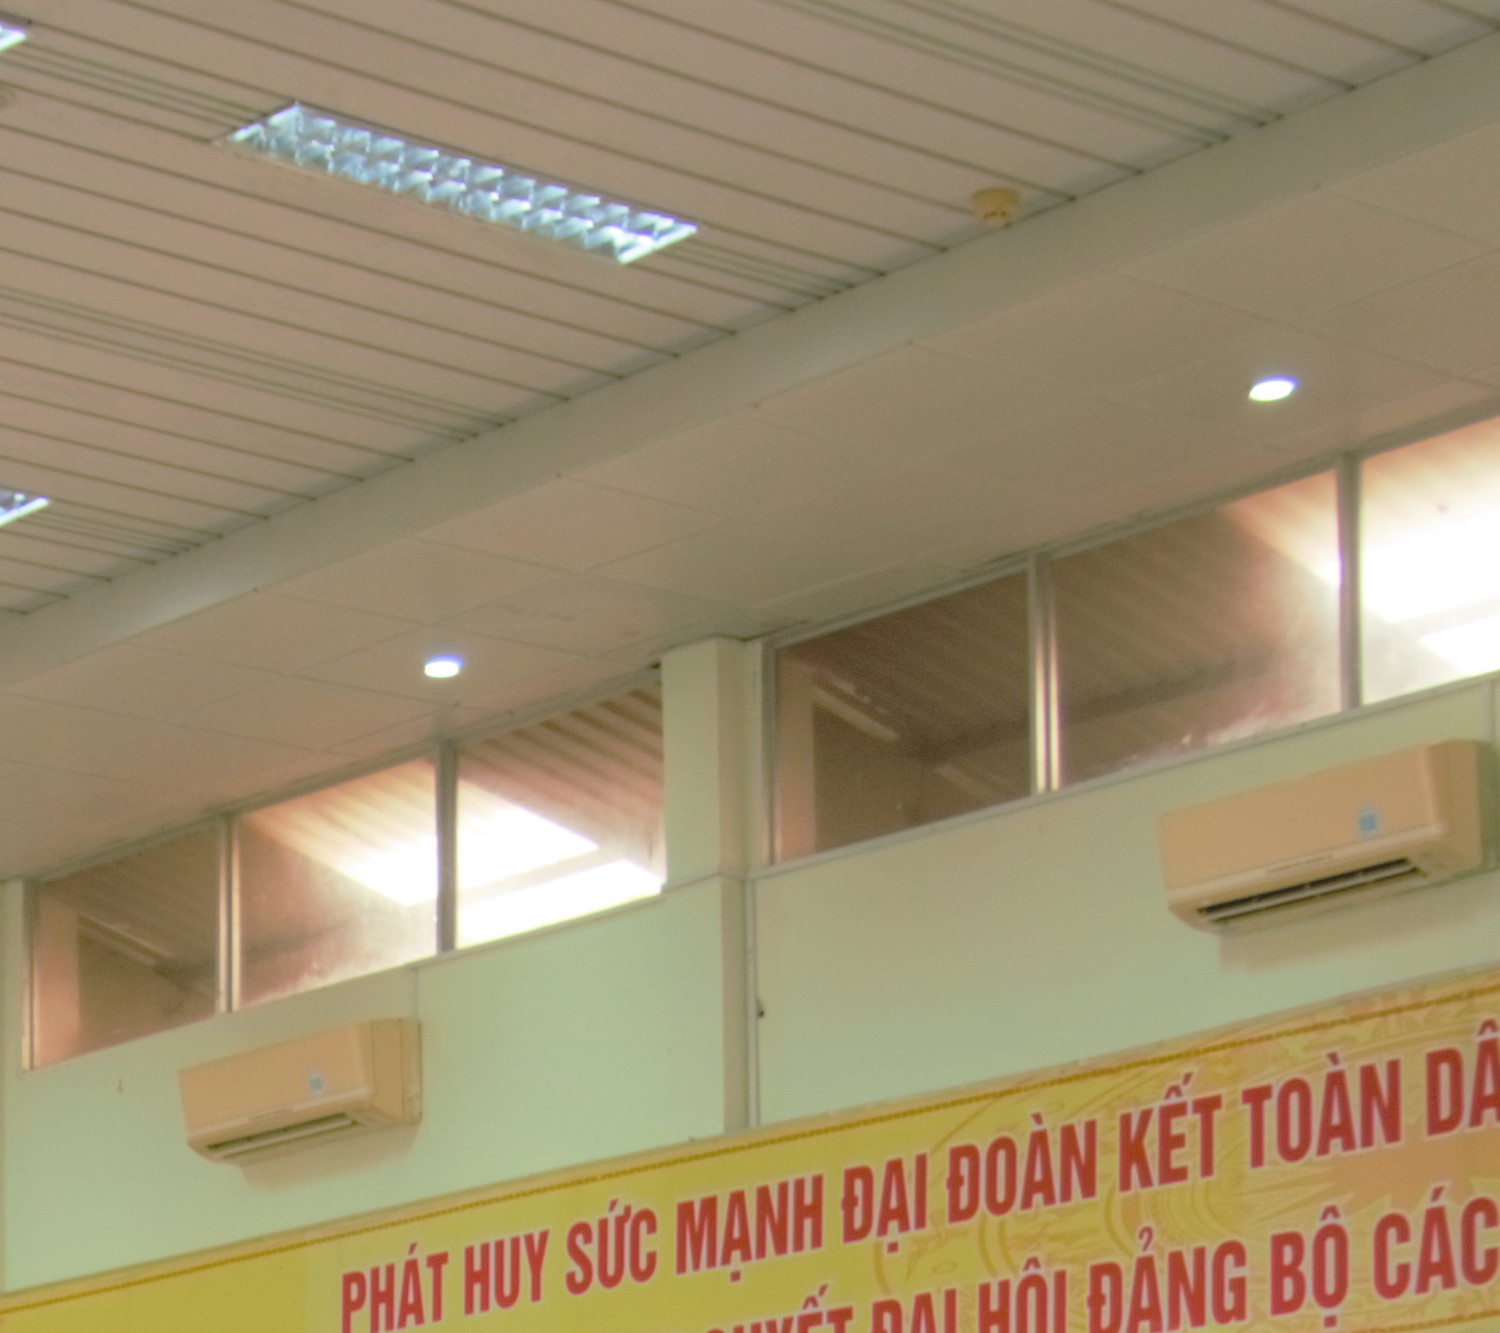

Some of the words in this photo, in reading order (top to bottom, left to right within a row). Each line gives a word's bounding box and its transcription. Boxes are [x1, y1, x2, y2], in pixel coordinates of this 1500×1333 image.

[463, 1230, 549, 1315] HUY
[566, 1200, 657, 1295] SỨC
[675, 1173, 823, 1282] MẠNH
[841, 1153, 928, 1253] ĐẠI
[946, 1113, 1097, 1224] ĐOÀN
[1119, 1072, 1223, 1193] KẾT
[1242, 1052, 1400, 1168] TOÀN
[1270, 1205, 1348, 1327] BỘ
[1373, 1186, 1500, 1298] CÁC
